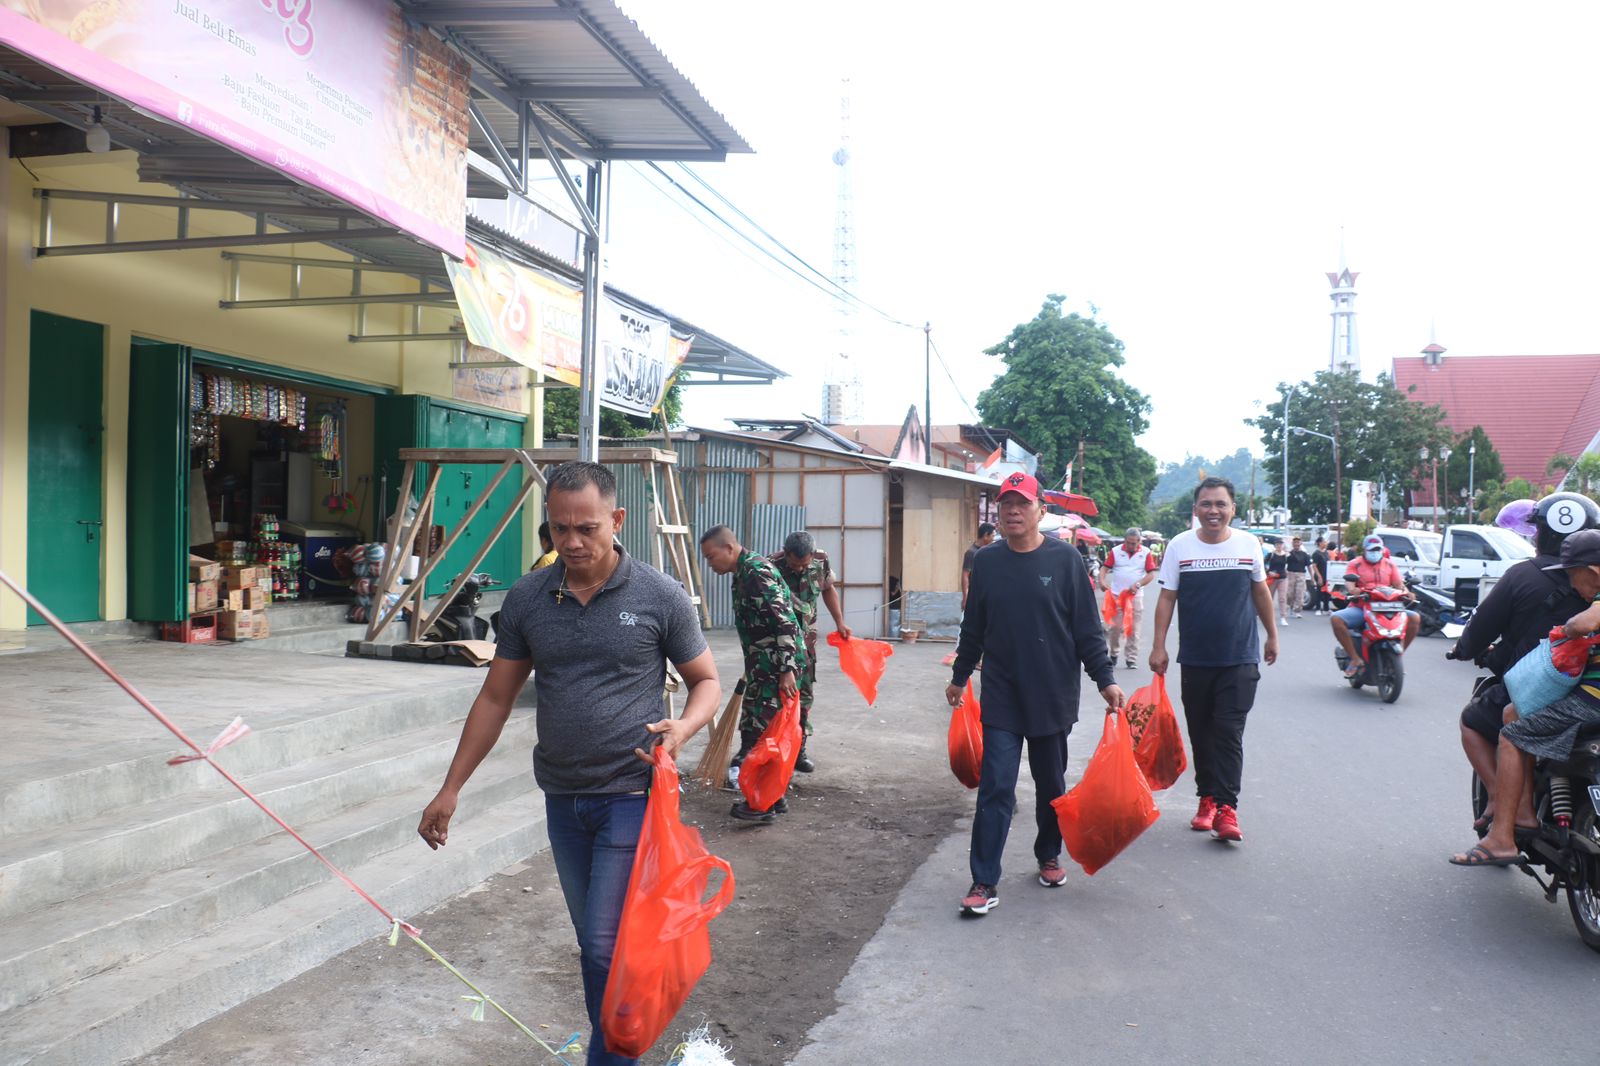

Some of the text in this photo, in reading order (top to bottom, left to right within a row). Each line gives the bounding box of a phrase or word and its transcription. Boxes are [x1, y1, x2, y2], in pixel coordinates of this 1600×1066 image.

[173, 0, 199, 24] Jual
[203, 14, 224, 39] Beli
[228, 28, 257, 57] Emas
[247, 86, 281, 114] Fashion
[305, 118, 336, 145] Branded
[305, 71, 374, 121] Menerima Pesanan
[315, 90, 364, 127] Cincin Kawin
[241, 97, 260, 119] Baju
[262, 107, 299, 137] Premium
[300, 126, 328, 151] Import
[620, 314, 652, 348] TOKO
[1559, 506, 1573, 526] 8
